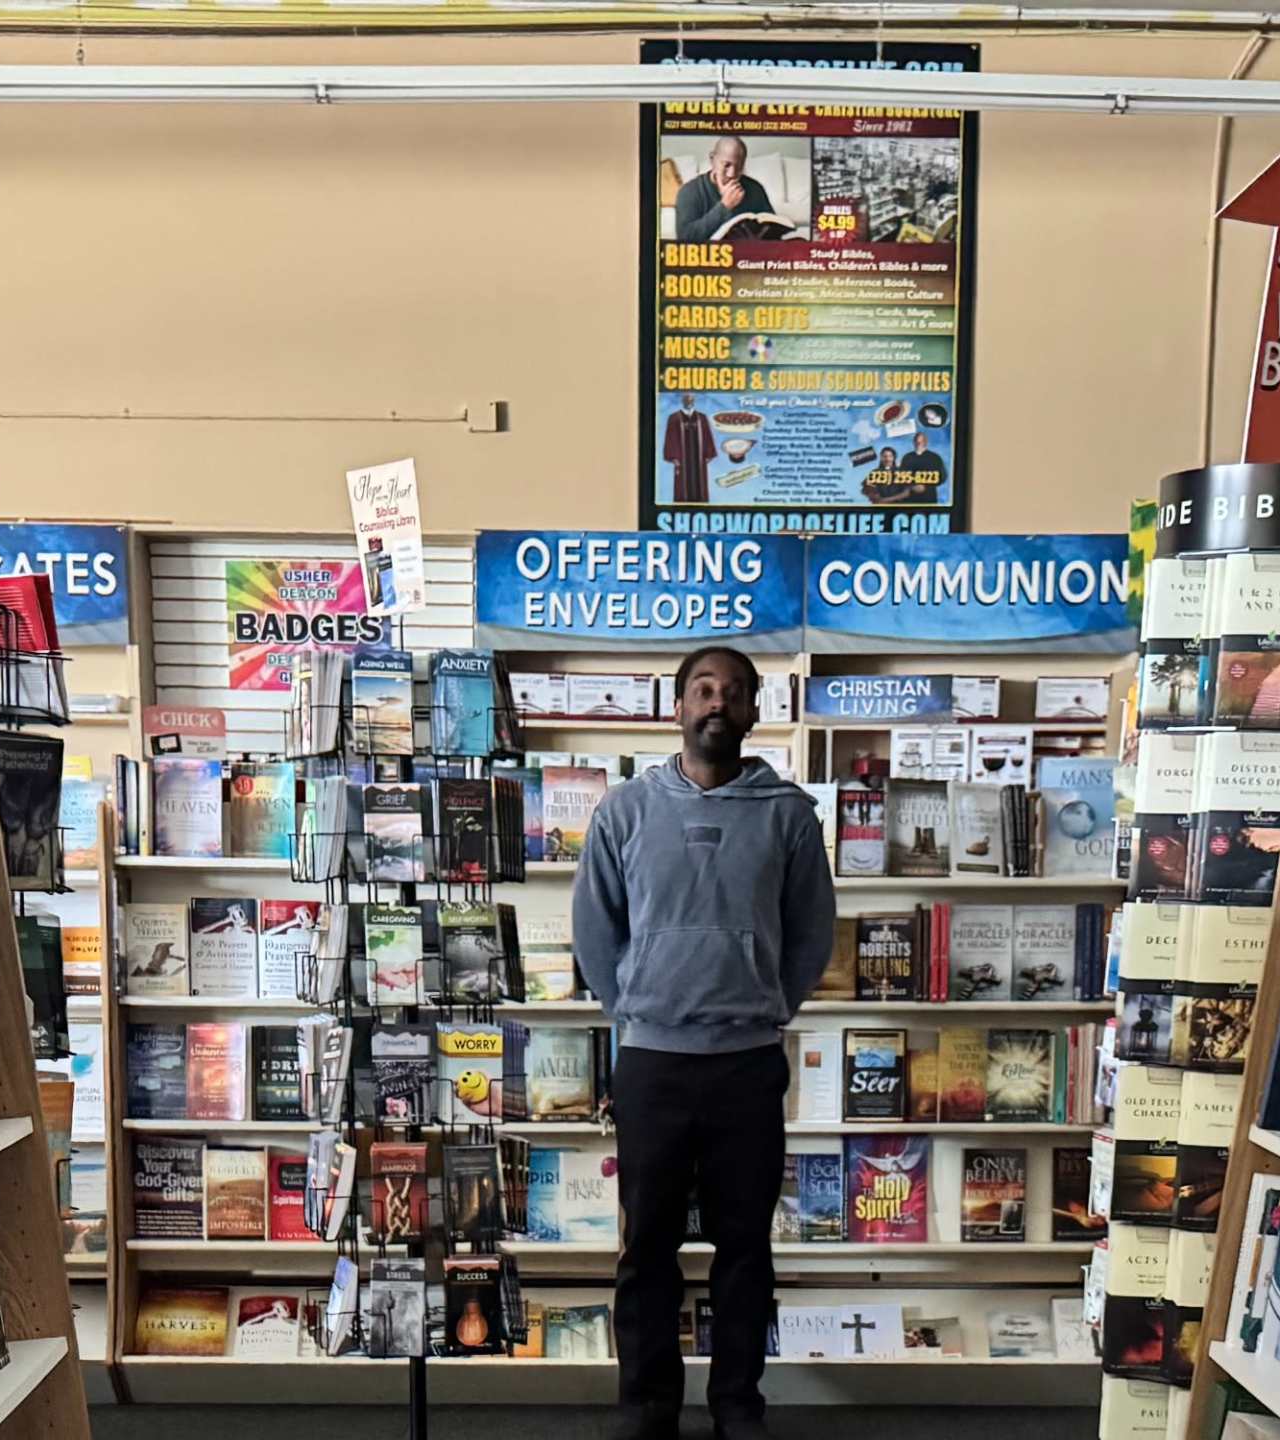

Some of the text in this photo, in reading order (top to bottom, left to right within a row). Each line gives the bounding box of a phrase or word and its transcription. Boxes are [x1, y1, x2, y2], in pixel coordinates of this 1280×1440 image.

[818, 216, 856, 231] $4.99
[664, 244, 734, 268] BIBLES
[810, 249, 840, 260] Study
[737, 260, 765, 271] Giant
[664, 275, 733, 299] BOOKS
[664, 305, 811, 331] CARDS & GIFTS
[664, 336, 732, 360] MUSIC
[664, 366, 747, 391] CHURCH
[751, 369, 765, 390] &
[884, 371, 951, 392] SUPPLIES
[514, 537, 765, 584] OFFERING
[283, 570, 332, 583] USHER
[817, 557, 1129, 607] COMMUNION
[279, 587, 337, 601] DEACON
[525, 590, 755, 631] ENVELOPES
[233, 612, 384, 645] BADGES
[440, 656, 490, 673] ANXIETY
[826, 679, 932, 699] CHRISTIAN
[839, 697, 918, 716] LIVING
[160, 711, 212, 729] CHICK
[160, 799, 218, 815] HEAVEN
[376, 793, 408, 807] GRIEF
[371, 914, 417, 926] CAREGIVING
[952, 927, 1011, 941] MIRACLES
[1015, 927, 1075, 941] MIRACLES
[858, 942, 912, 958] ROBERTS
[453, 1036, 497, 1052] WORRY
[850, 1072, 901, 1095] Seer
[137, 1144, 200, 1162] Discover
[143, 1157, 175, 1174] Your
[972, 1155, 1019, 1171] ONLY
[135, 1172, 205, 1189] God-Given
[965, 1168, 1025, 1184] BELIEVE
[163, 1186, 197, 1202] Gifts
[873, 1174, 911, 1201] Holy
[854, 1194, 903, 1222] Spirit
[456, 1270, 489, 1282] SUCCESS
[143, 1317, 218, 1332] HARVEST
